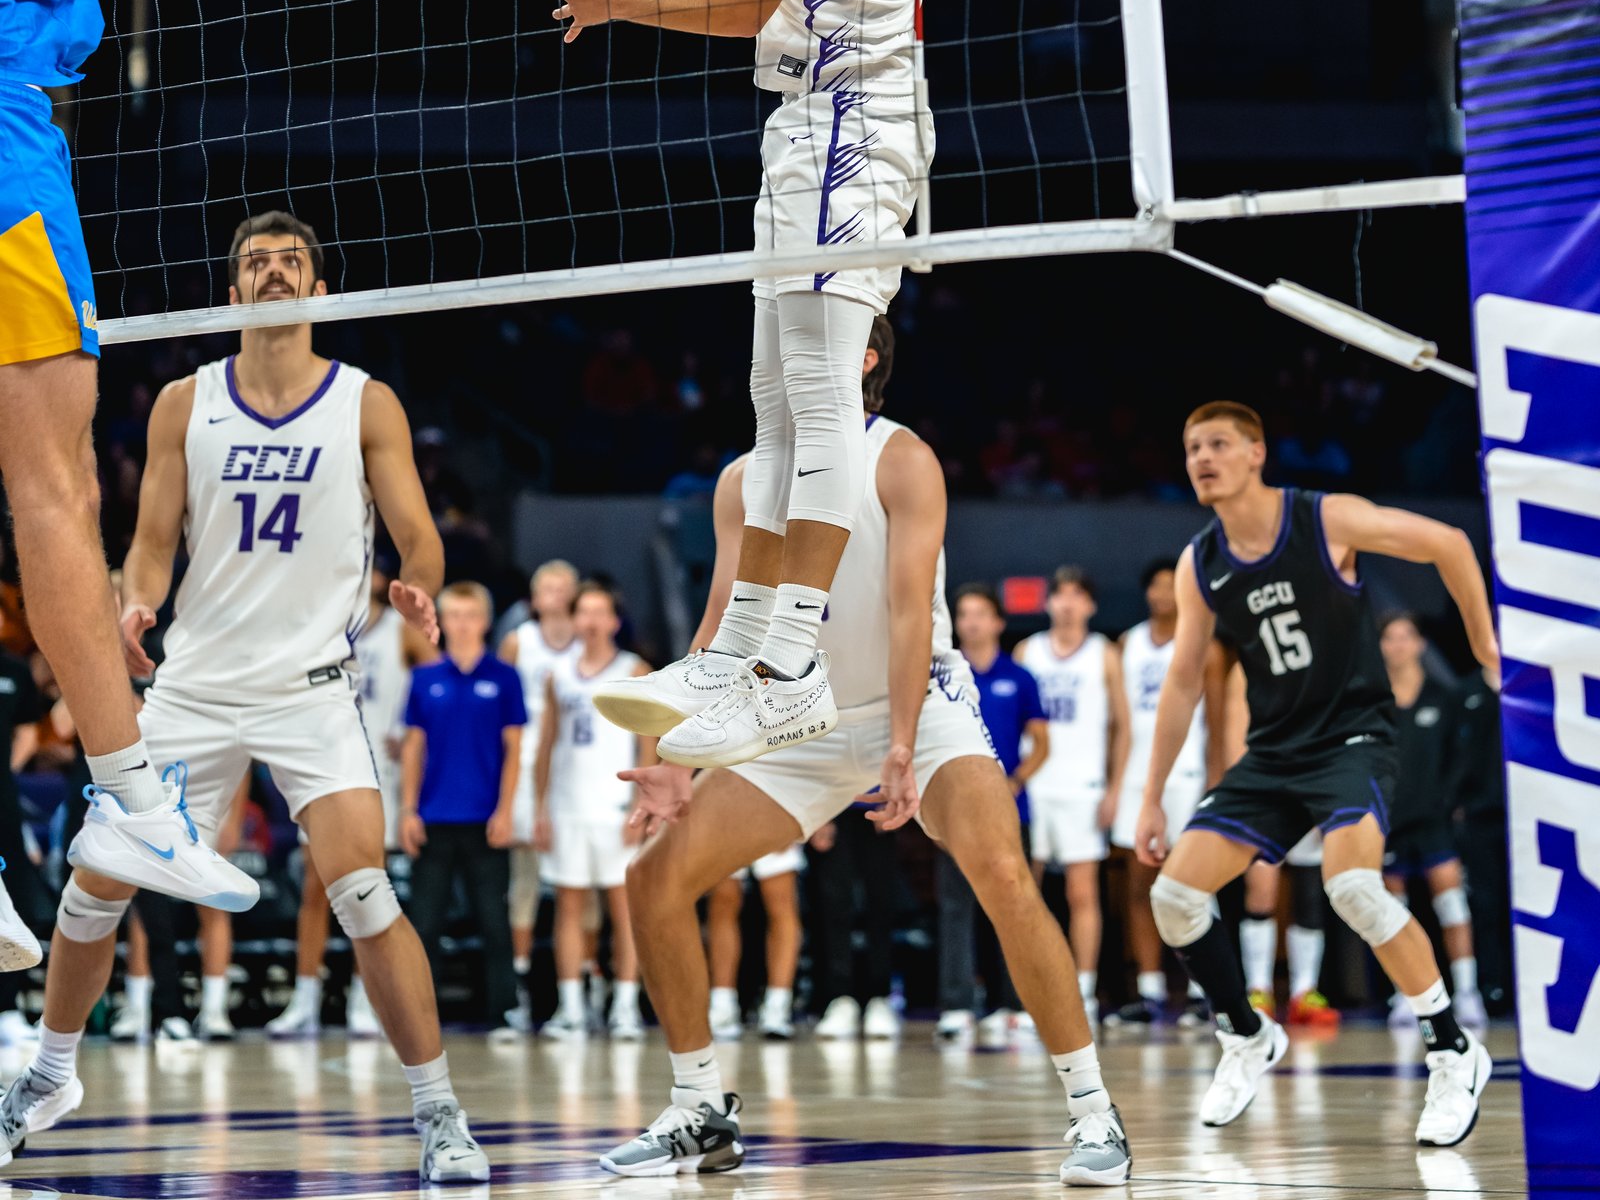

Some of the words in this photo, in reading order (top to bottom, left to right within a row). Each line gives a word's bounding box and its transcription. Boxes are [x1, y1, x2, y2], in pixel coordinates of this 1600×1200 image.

[221, 445, 323, 482] GCU
[233, 492, 303, 553] 14
[1247, 581, 1296, 615] GCU
[1259, 609, 1313, 676] 15
[767, 728, 803, 746] ROMANS
[808, 721, 826, 734] 12:2
